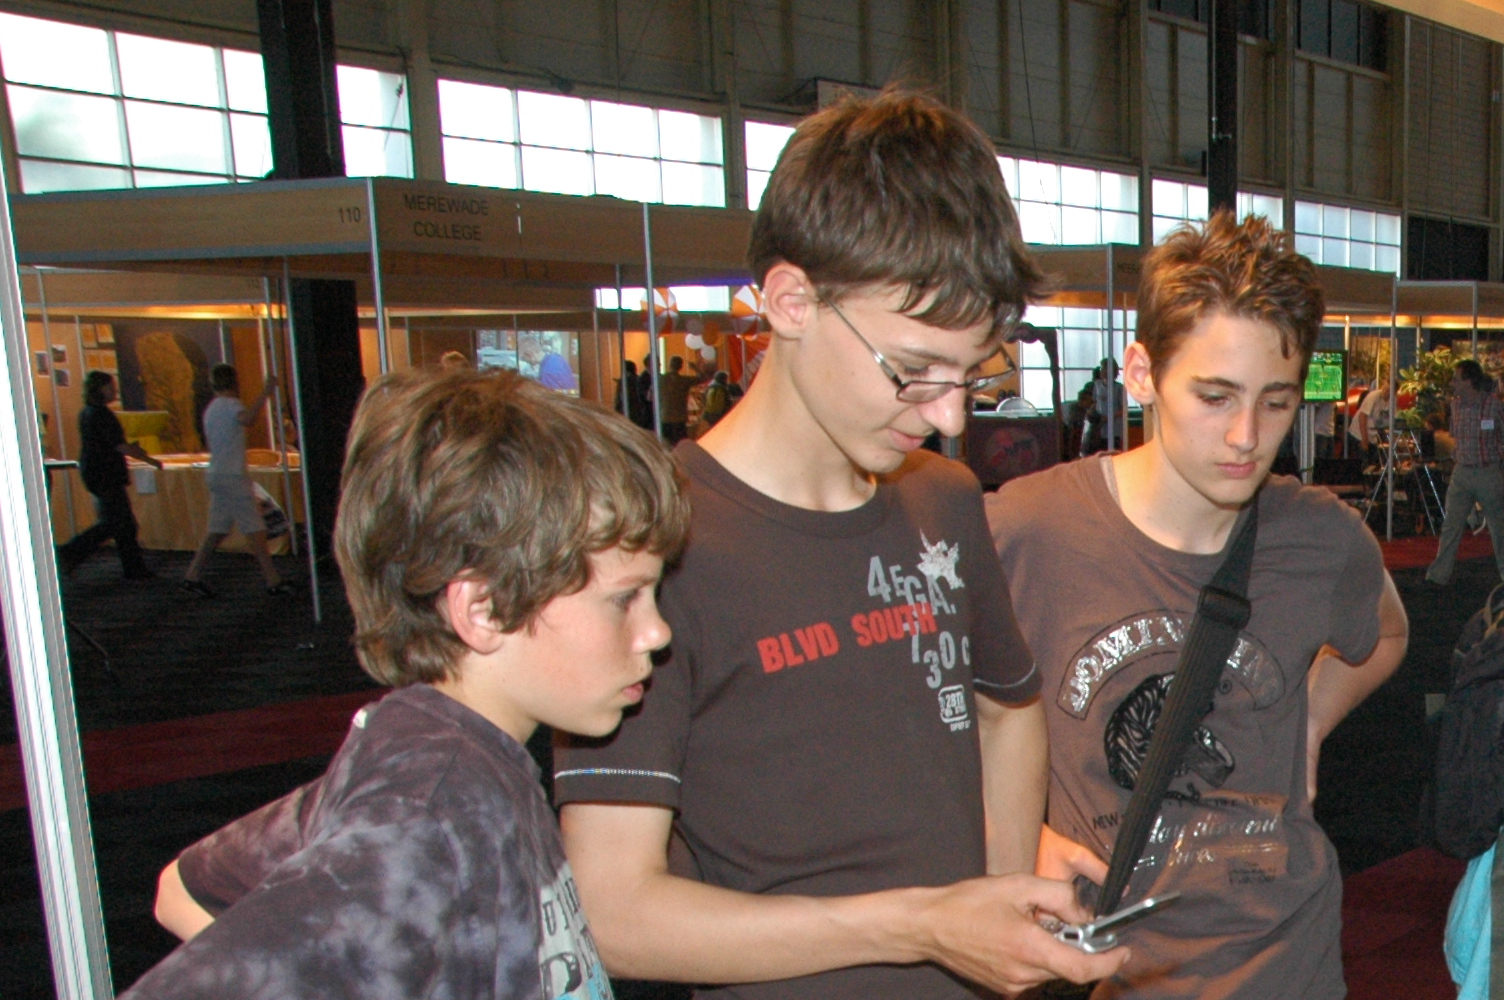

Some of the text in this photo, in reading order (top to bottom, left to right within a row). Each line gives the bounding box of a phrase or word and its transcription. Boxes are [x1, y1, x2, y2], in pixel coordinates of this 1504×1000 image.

[338, 207, 361, 223] 110
[403, 194, 489, 216] MEREWADE
[413, 221, 481, 241] COLLEGE
[756, 601, 938, 673] BLVD SOUTH
